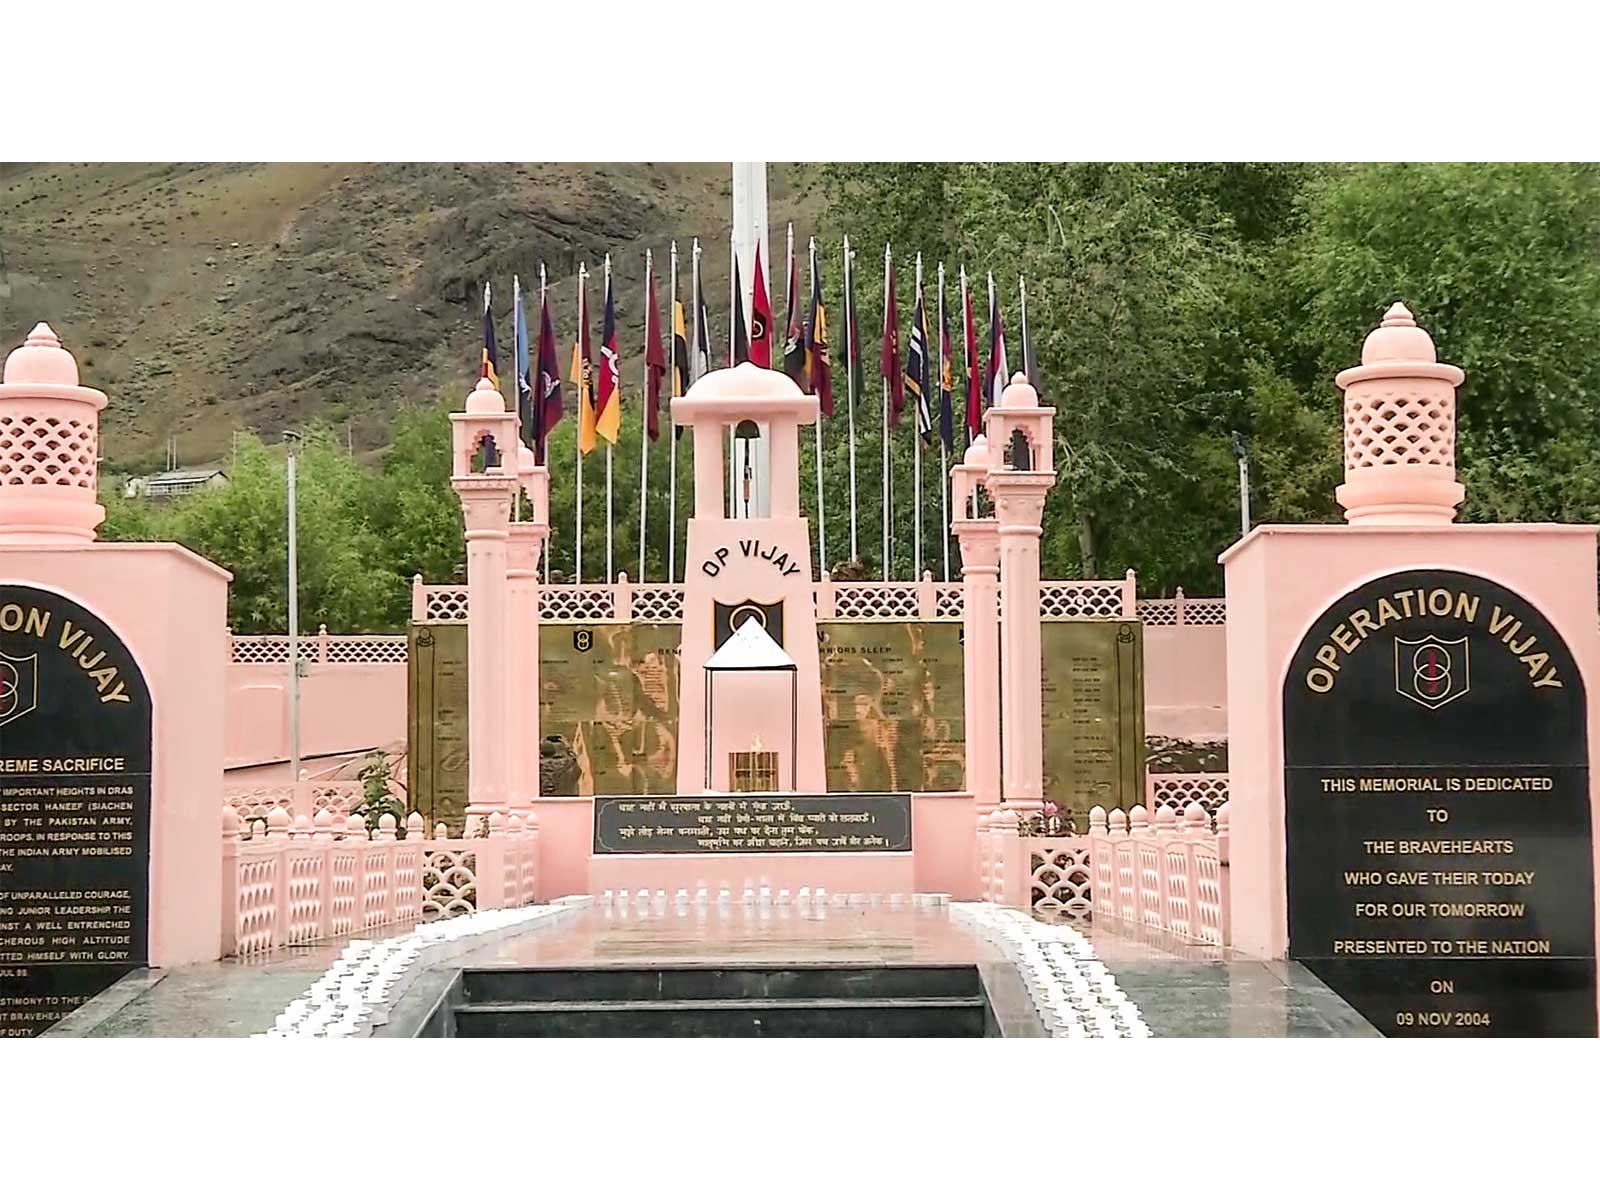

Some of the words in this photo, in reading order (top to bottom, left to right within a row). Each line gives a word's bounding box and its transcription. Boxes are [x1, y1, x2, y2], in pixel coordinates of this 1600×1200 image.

[702, 547, 729, 577] OP
[739, 540, 800, 576] VIJAY
[1306, 588, 1480, 694] OPERATION
[1488, 606, 1563, 690] VIJAY
[58, 621, 130, 703] VIJAY
[42, 758, 125, 771] SACRIFICE
[2, 787, 55, 796] IMPORTANT
[57, 787, 96, 795] HEIGHTS
[97, 787, 106, 795] IN
[108, 786, 134, 795] DRAS
[1321, 779, 1356, 792] THIS
[1359, 778, 1442, 791] MEMORIAL
[1446, 778, 1461, 791] IS
[1465, 778, 1553, 791] DEDICATED
[1, 803, 40, 812] SECTOR
[44, 802, 84, 811] HANEEF
[88, 802, 133, 811] (SIACHEN
[4, 818, 17, 826] BY
[23, 818, 43, 826] THE
[49, 817, 97, 826] PAKISTAN
[1427, 809, 1448, 822] TO
[36, 833, 46, 841] IN
[47, 832, 97, 841] RESPONSE
[98, 832, 111, 840] TO
[112, 832, 133, 840] THIS
[17, 848, 49, 857] INDIAN
[52, 847, 80, 856] ARMY
[82, 847, 133, 856] MOBILISED
[1364, 841, 1395, 854] THE
[1399, 840, 1514, 854] BRAVEHEARTS
[1344, 872, 1382, 885] WHO
[1386, 872, 1429, 885] GAVE
[1432, 872, 1479, 885] THEIR
[1482, 871, 1535, 885] TODAY
[11, 891, 83, 900] UNPARALLELED
[17, 906, 51, 915] JUNIOR
[112, 905, 132, 914] THE
[1355, 904, 1389, 917] FOR
[1392, 904, 1427, 917] OUR
[1430, 904, 1525, 917] TOMORROW
[24, 922, 32, 930] A
[36, 922, 63, 930] WELL
[67, 921, 131, 930] ENTRENCHED
[52, 936, 76, 945] HIGH
[83, 936, 131, 945] ALTITUDE
[1334, 941, 1427, 954] PRESENTED
[1431, 941, 1453, 954] TO
[1456, 941, 1488, 954] THE
[1491, 940, 1550, 954] NATION
[28, 952, 66, 961] HIMSELF
[70, 951, 94, 960] WITH
[1430, 981, 1454, 994] ON
[45, 996, 59, 1005] TO
[61, 996, 81, 1005] THE
[1397, 1013, 1414, 1026] 09
[1418, 1013, 1451, 1026] NOV
[1456, 1013, 1490, 1026] 2004
